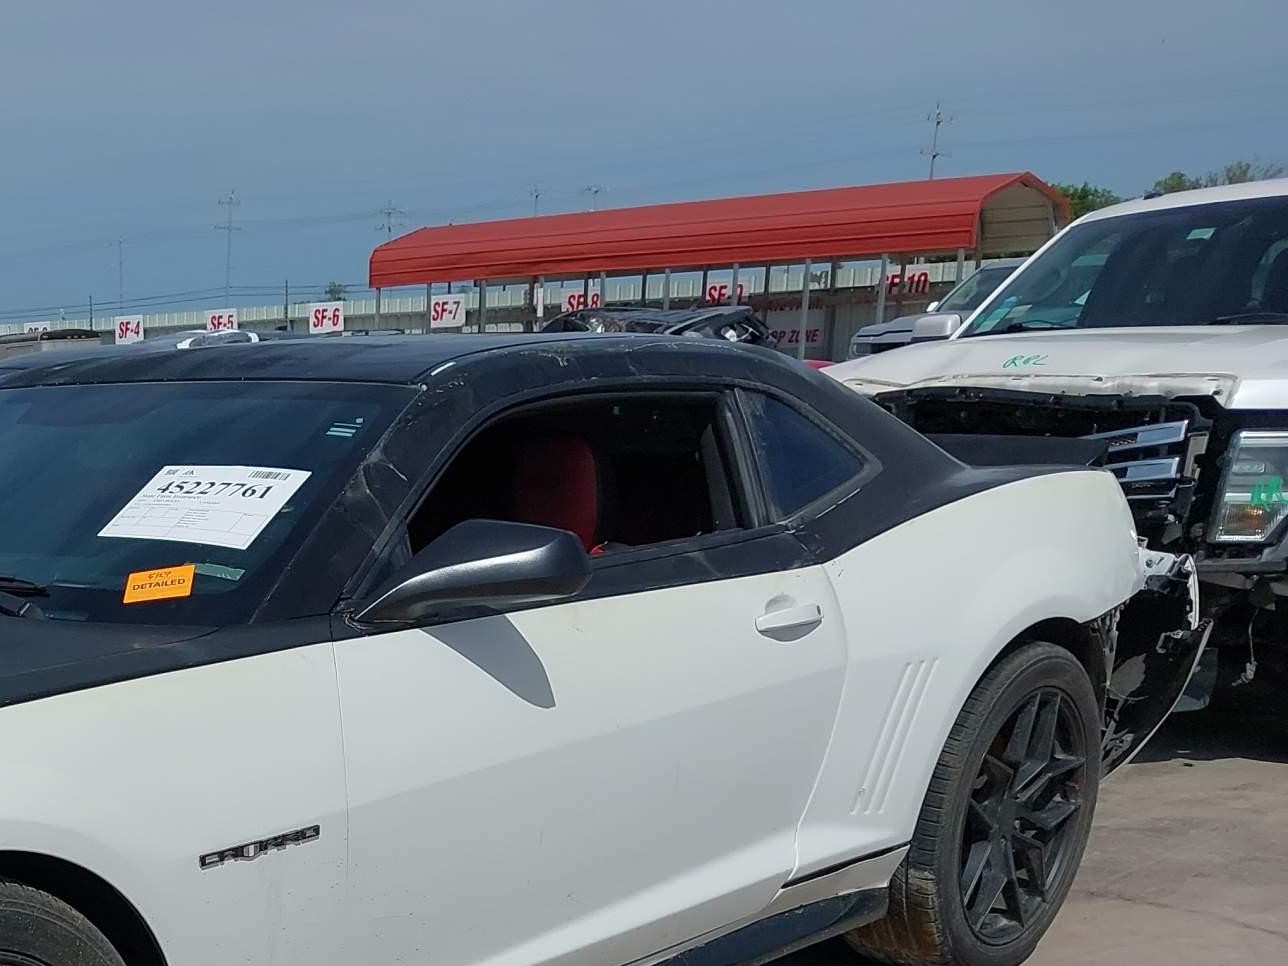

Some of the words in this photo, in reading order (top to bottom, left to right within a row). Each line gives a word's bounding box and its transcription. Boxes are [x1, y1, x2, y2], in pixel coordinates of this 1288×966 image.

[312, 307, 340, 328] SF-6
[431, 300, 461, 321] SF-7
[117, 320, 140, 340] SF-4
[156, 480, 274, 499] 45227761
[132, 578, 185, 591] DETAILED
